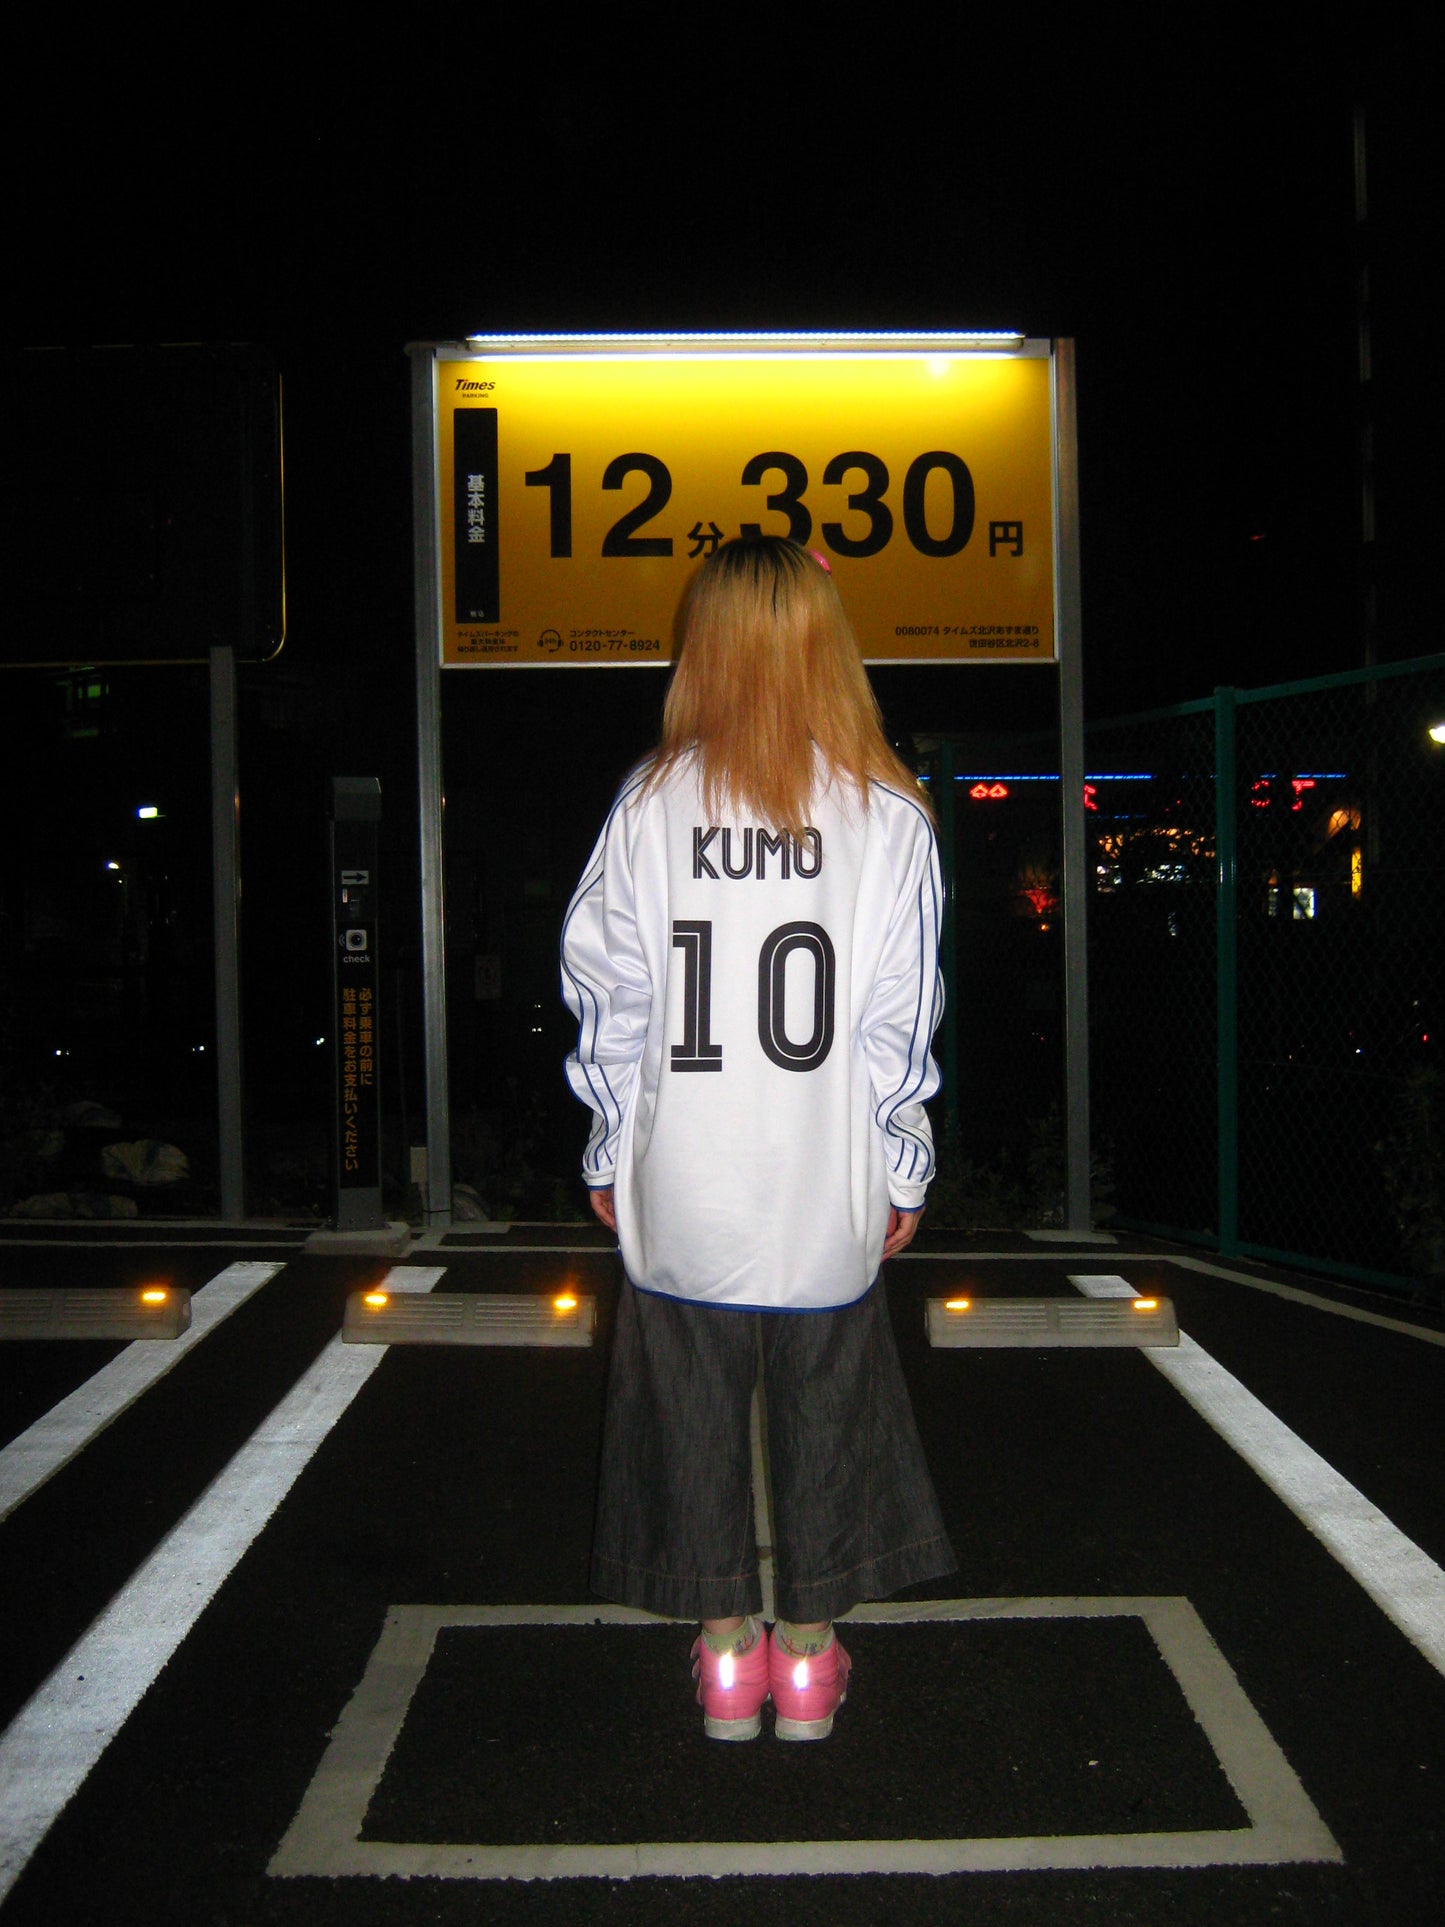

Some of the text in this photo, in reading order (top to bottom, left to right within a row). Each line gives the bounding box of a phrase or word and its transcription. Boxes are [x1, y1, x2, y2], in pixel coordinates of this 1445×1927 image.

[455, 378, 496, 391] Times
[467, 474, 485, 543] 基本料金
[569, 629, 636, 638] コンタクトセンター
[569, 639, 660, 652] 0120-77-8924
[692, 826, 823, 881] KUMO
[343, 953, 371, 963] check
[670, 919, 836, 1073] 10
[358, 986, 374, 1086] 必ず乗車の前に
[342, 986, 359, 1172] 駐車料金をお支払いください
